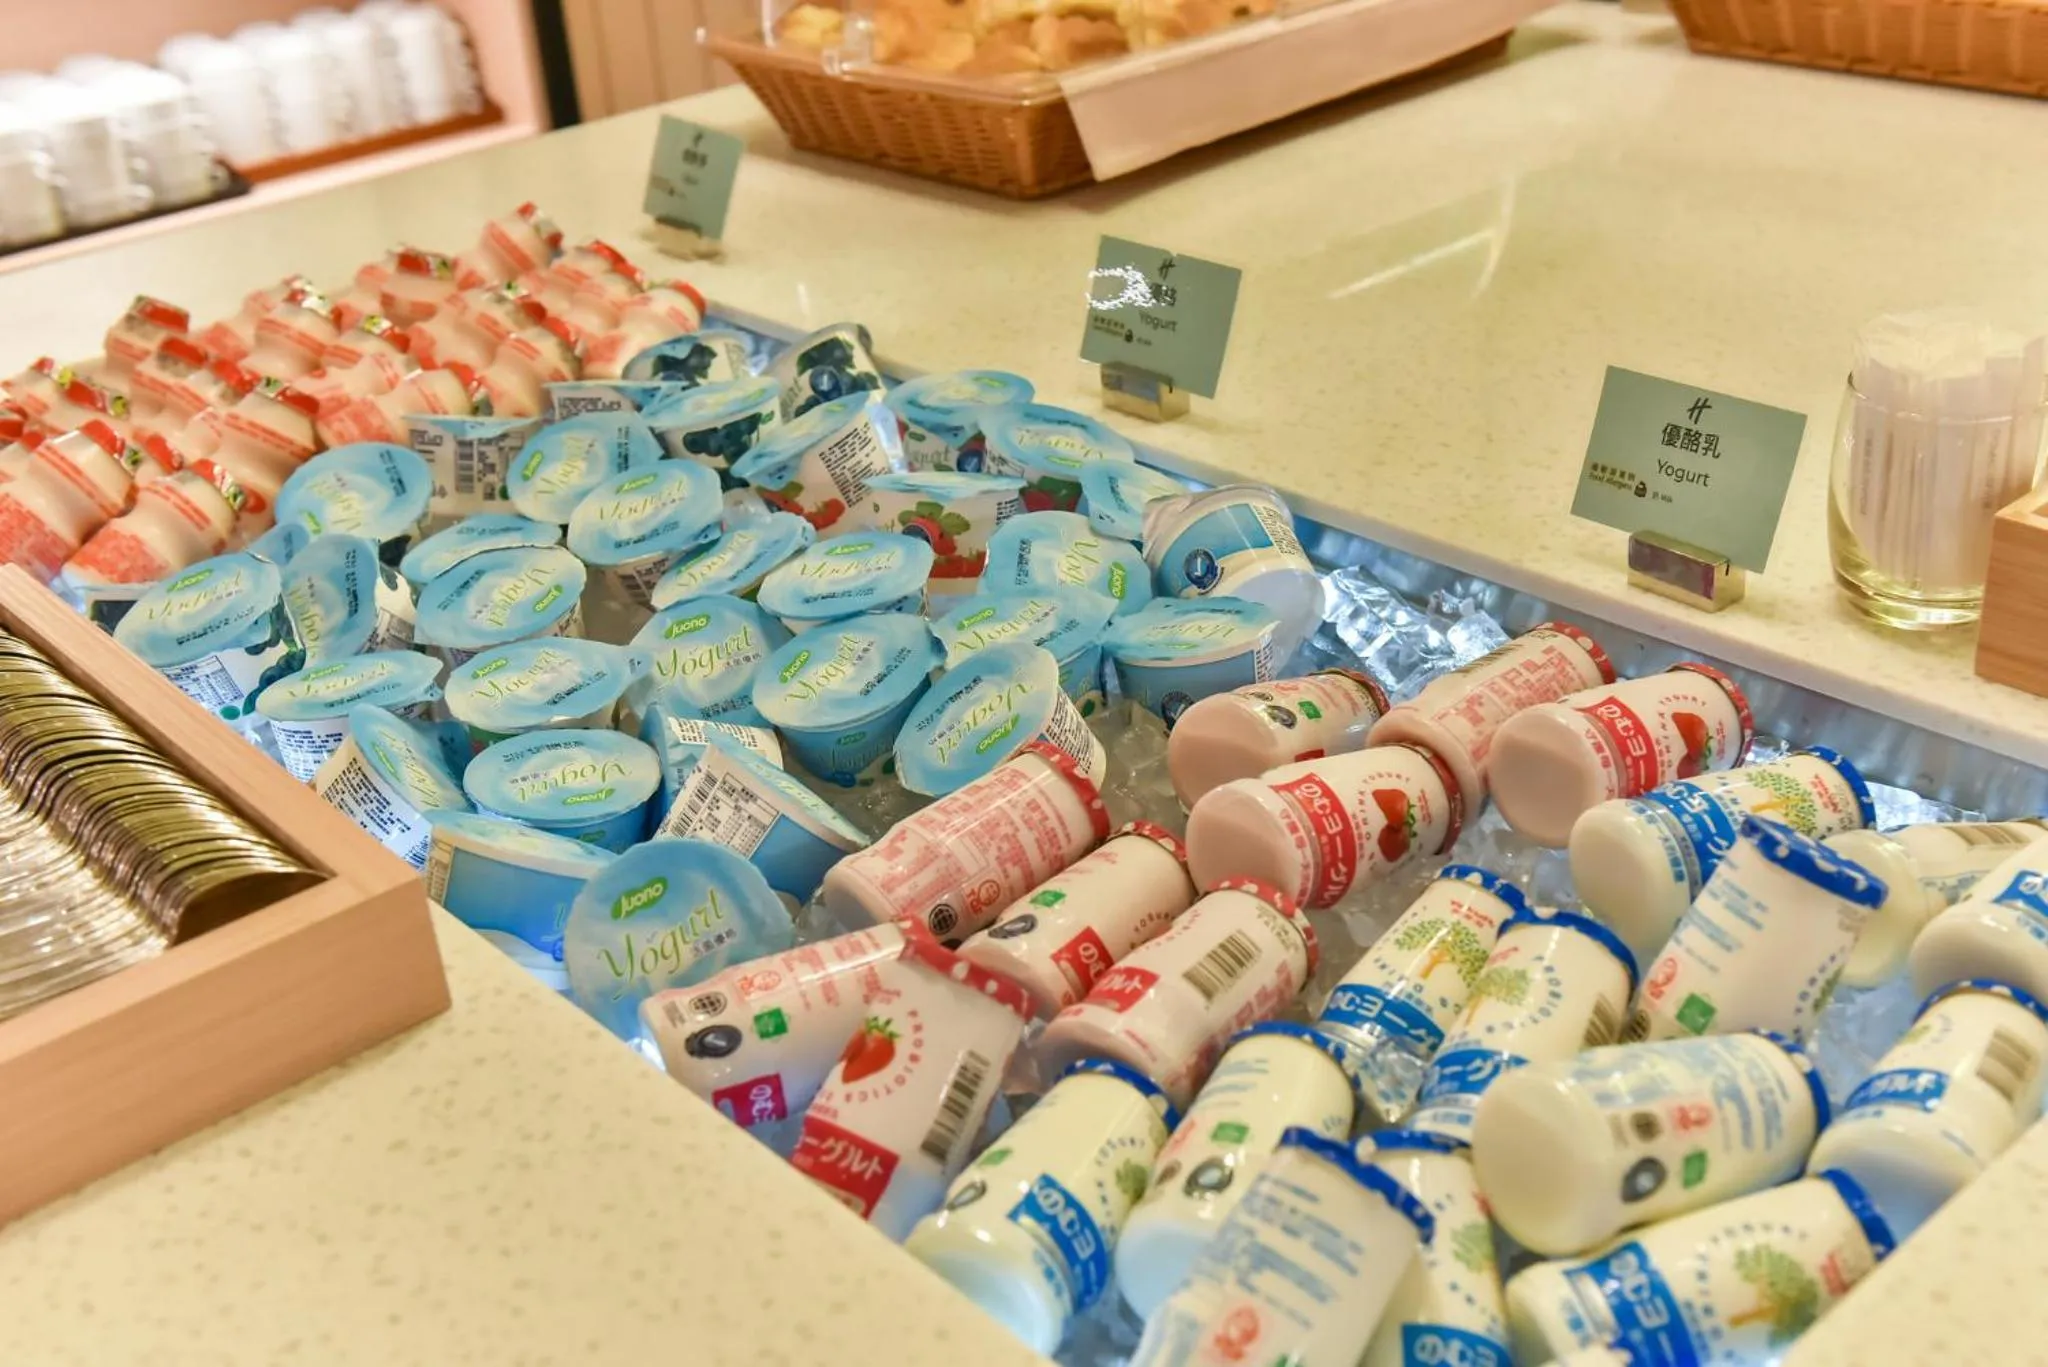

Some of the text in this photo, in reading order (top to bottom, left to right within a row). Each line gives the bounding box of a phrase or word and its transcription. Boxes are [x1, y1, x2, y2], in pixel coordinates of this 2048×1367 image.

[1139, 311, 1178, 332] Yogurt
[1661, 422, 1722, 459] 優酪乳
[1657, 458, 1711, 487] Yogurt
[595, 887, 725, 984] Yogurt
